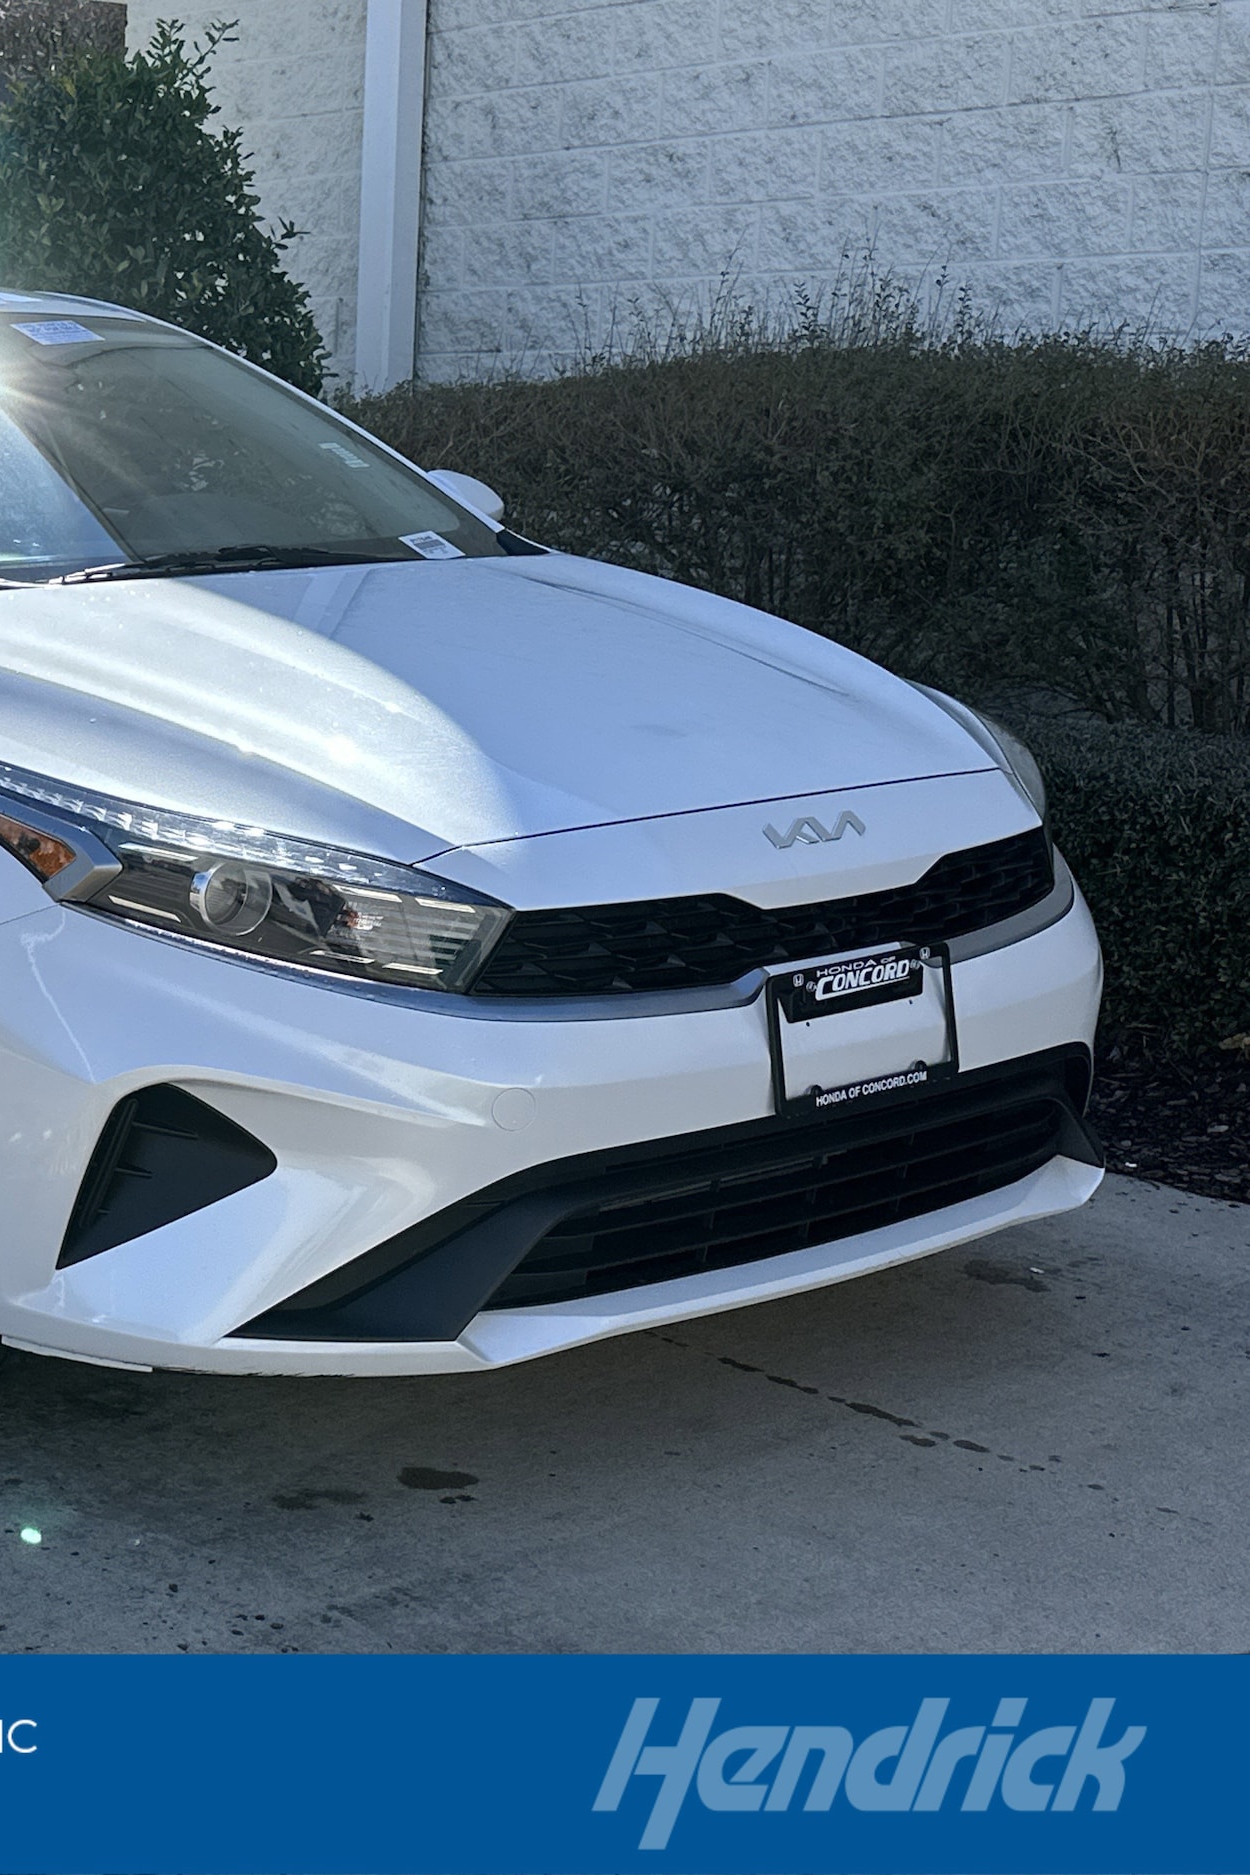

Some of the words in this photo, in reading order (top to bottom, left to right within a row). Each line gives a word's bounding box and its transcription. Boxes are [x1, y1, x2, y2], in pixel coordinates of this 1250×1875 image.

[762, 809, 867, 849] KIA
[815, 959, 910, 1001] CONCORD
[816, 959, 877, 978] HONDA
[880, 955, 896, 965] OF
[815, 1090, 848, 1107] HONDA
[848, 1086, 862, 1099] OF
[862, 1071, 928, 1095] CONCORD.COM
